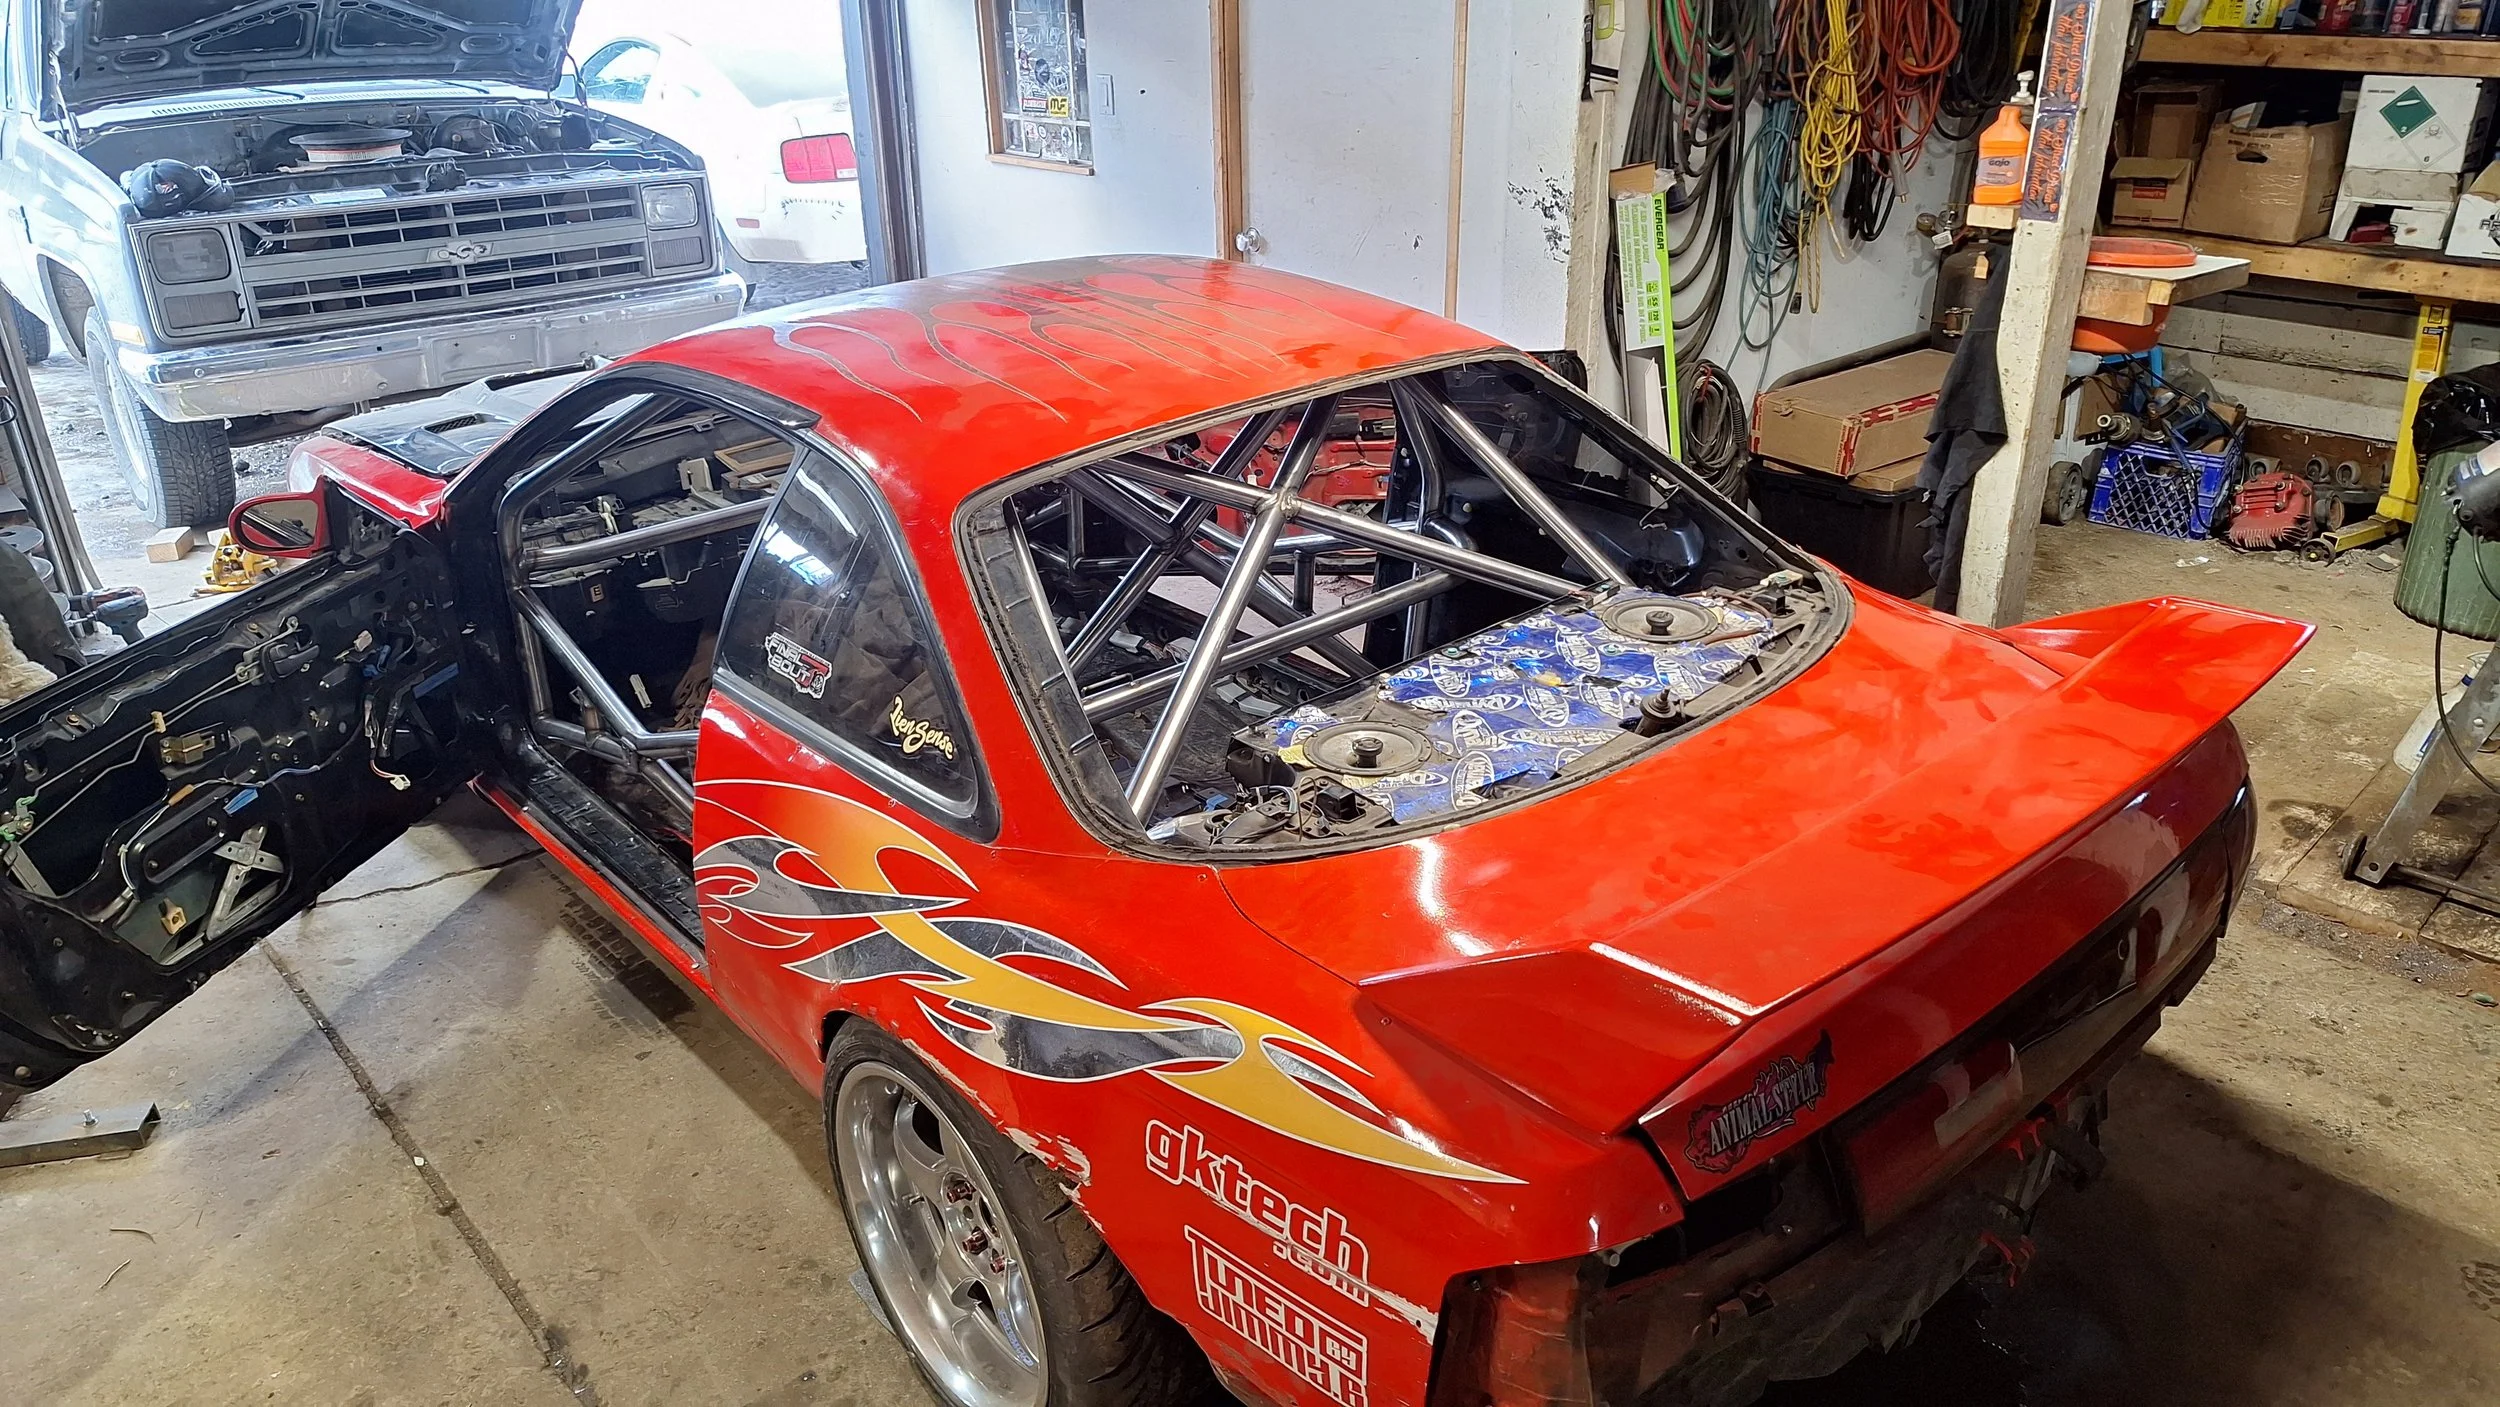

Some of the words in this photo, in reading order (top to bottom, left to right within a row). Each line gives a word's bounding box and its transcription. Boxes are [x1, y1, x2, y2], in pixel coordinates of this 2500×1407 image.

[1655, 199, 1665, 250] EVERGEAR
[768, 637, 806, 667] FINAL
[771, 655, 812, 684] BOUT
[1710, 1092, 1773, 1156] ANIMAL
[1771, 1062, 1819, 1117] STYLE
[1145, 1119, 1369, 1287] gktech
[1184, 1224, 1322, 1354] TUNED
[1326, 1335, 1357, 1371] BY
